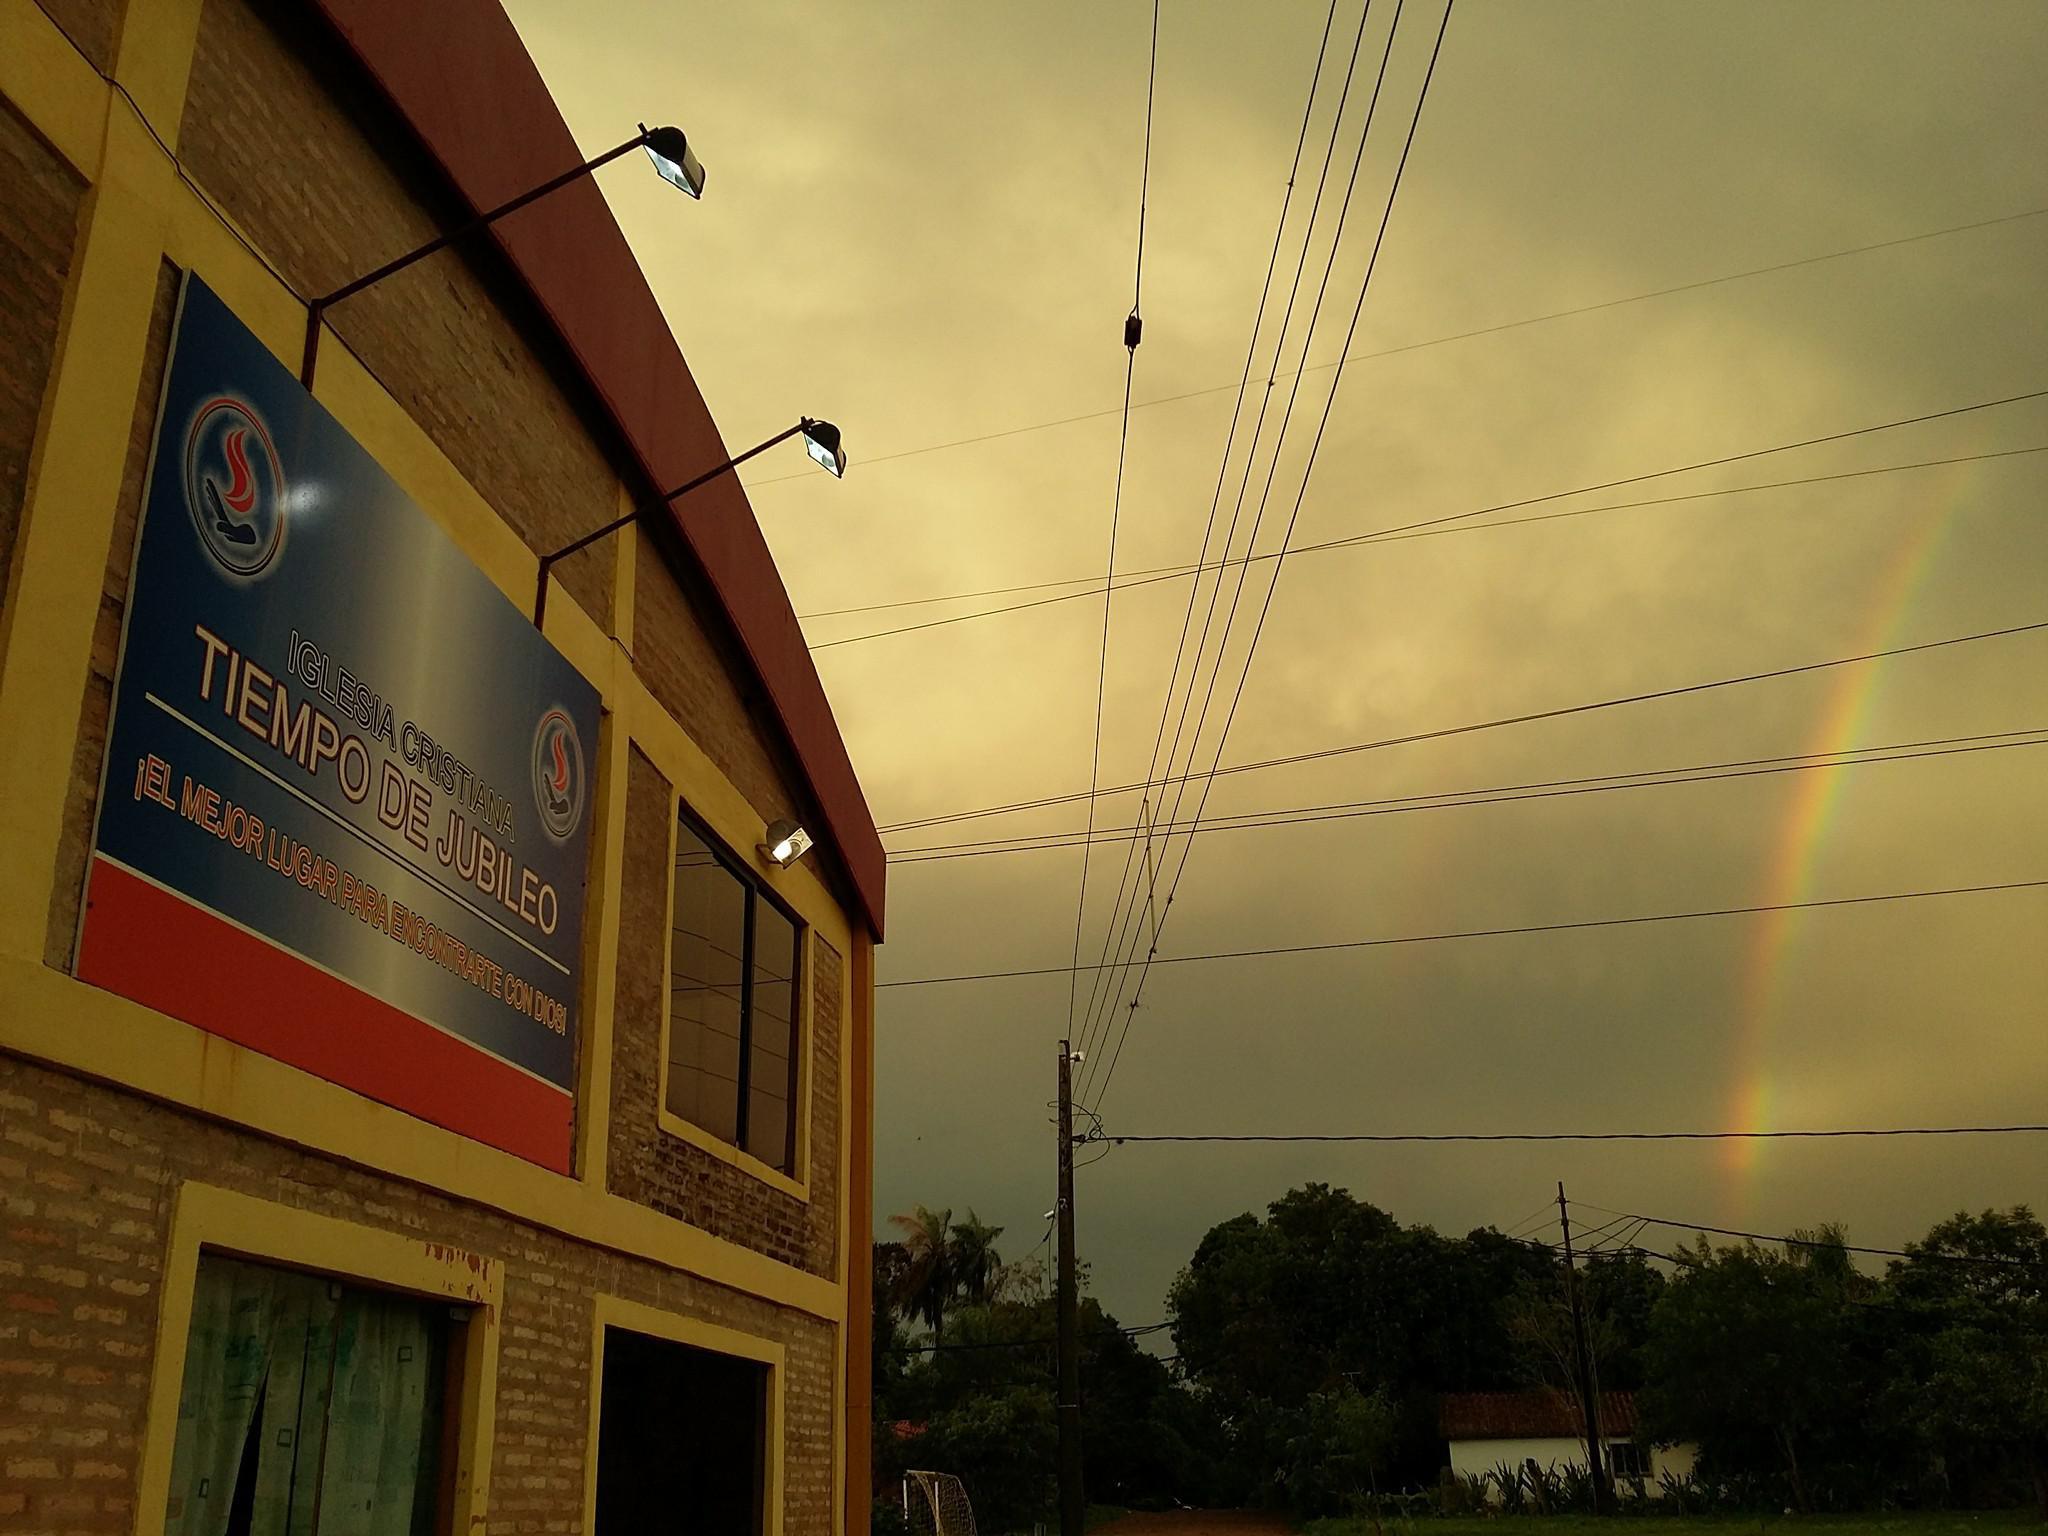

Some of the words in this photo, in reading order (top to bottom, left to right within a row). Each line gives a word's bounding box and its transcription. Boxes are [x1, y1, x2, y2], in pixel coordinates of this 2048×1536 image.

[195, 623, 371, 804] TIEMPO
[378, 759, 432, 852] DE
[436, 810, 559, 935] JUBILEO
[287, 630, 397, 753] IGLESIA
[400, 720, 515, 843] CRISTIANA
[134, 753, 176, 811] ¡EL
[180, 776, 264, 862] MEJOR
[266, 826, 338, 904] LUGAR
[340, 871, 389, 935] PARA
[390, 901, 503, 998] ENCONTRARTE
[504, 972, 534, 1017] CON
[534, 990, 567, 1036] DIOS!
